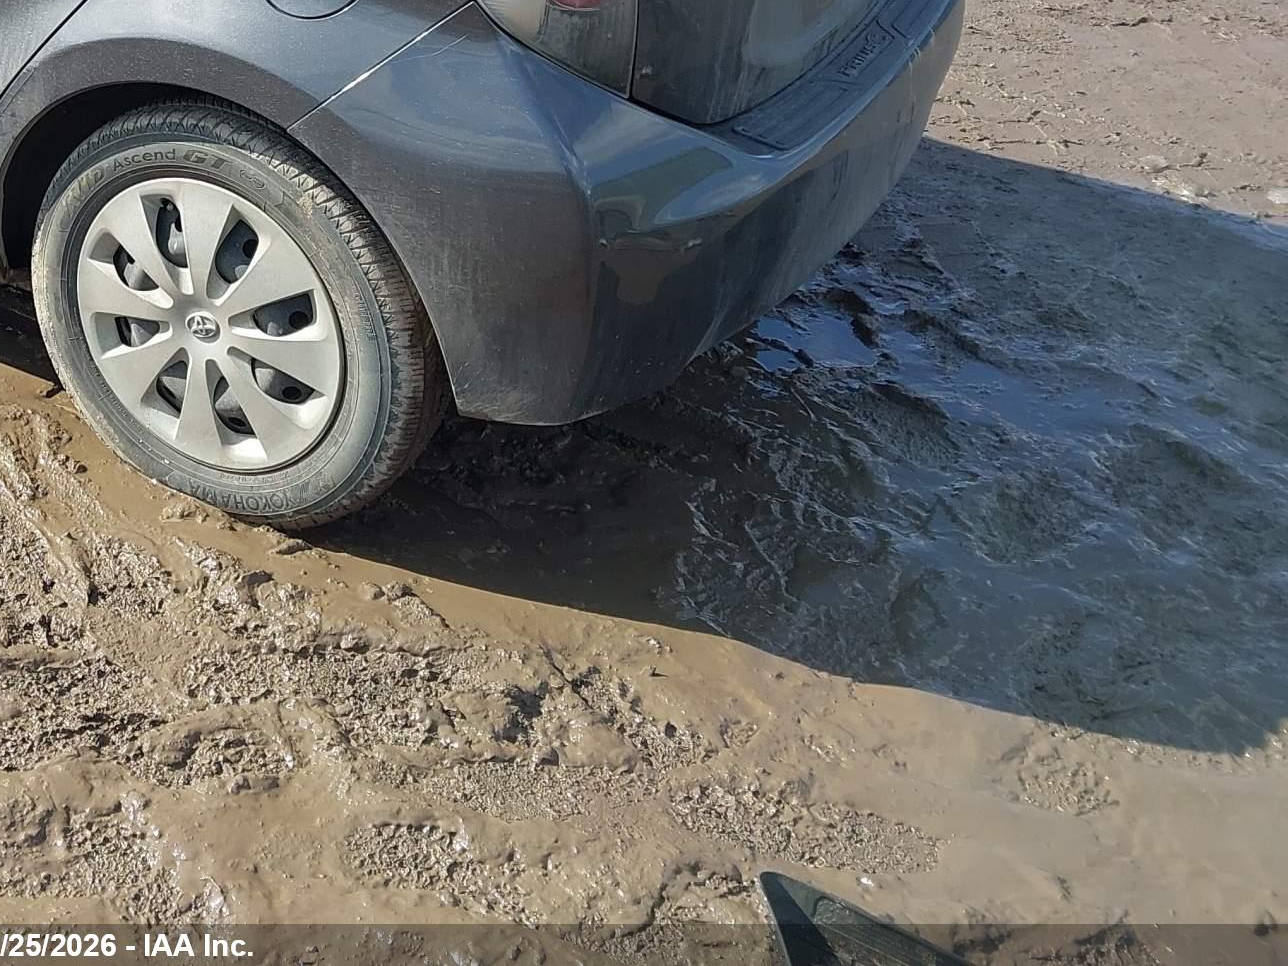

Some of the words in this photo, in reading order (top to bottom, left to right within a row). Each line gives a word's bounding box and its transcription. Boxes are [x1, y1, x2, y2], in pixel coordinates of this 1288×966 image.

[113, 148, 176, 172] Ascend
[183, 149, 234, 170] GT
[188, 479, 296, 512] YOKOHAMA
